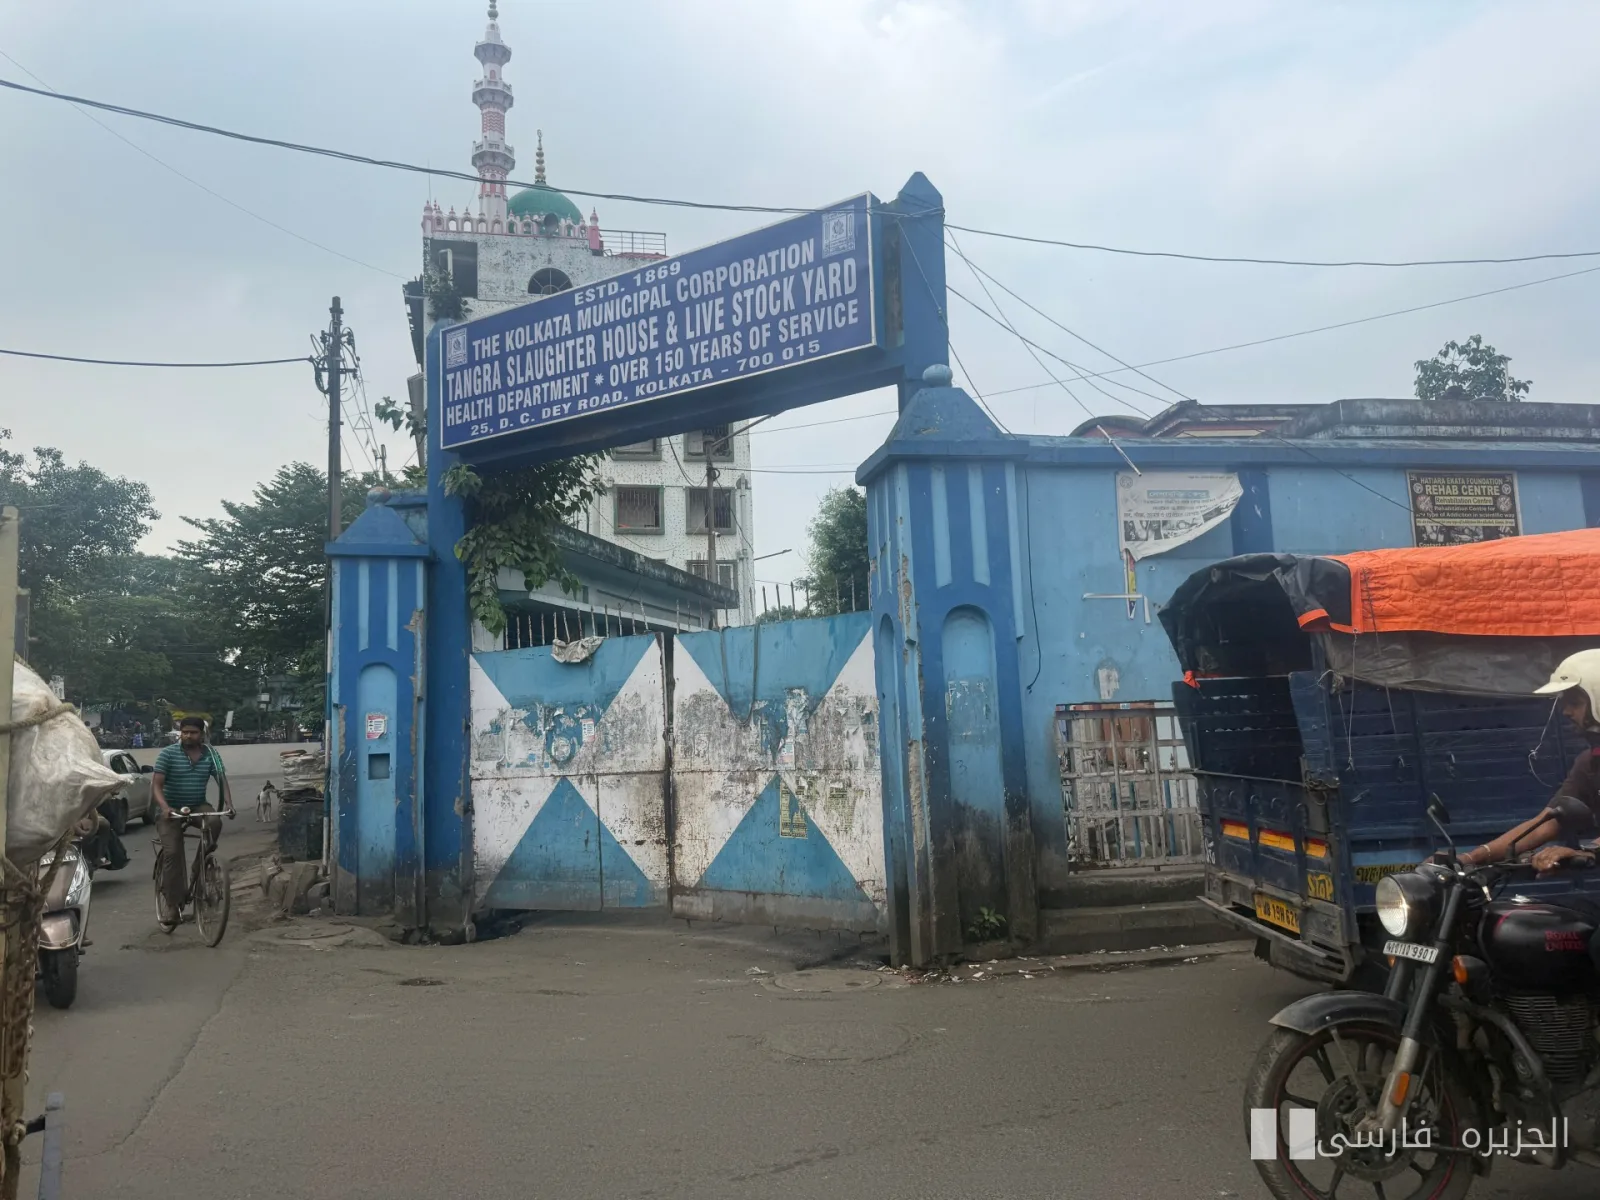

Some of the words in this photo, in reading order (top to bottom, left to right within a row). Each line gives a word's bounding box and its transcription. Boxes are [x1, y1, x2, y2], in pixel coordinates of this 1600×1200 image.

[446, 360, 501, 402] TANGRA
[507, 334, 596, 387] SLAUGHTER
[602, 315, 659, 362] HOUSE
[666, 310, 678, 345] &
[685, 296, 724, 340] LIVE
[732, 274, 795, 327] STOCK
[801, 257, 857, 306] YARD
[472, 334, 500, 361] THE
[505, 313, 572, 352] KOLKATA
[577, 283, 671, 332] MUNICIPAL
[676, 238, 814, 302] CORPORATION
[574, 281, 625, 306] ESTD.
[633, 261, 681, 287] 1869
[446, 397, 493, 426] HEALTH
[498, 372, 590, 414] DEPARTMENT
[609, 356, 649, 387] OVER
[655, 347, 684, 375] 150
[690, 331, 742, 366] YEARS
[749, 322, 771, 350] OF
[778, 298, 858, 343] SERVICE
[470, 422, 493, 436] 25,
[542, 402, 572, 419] DEY
[577, 391, 628, 411] ROAD,
[635, 368, 713, 397] KOLKATA
[736, 352, 774, 371] 700
[782, 339, 820, 360] 015
[1420, 477, 1446, 485] HATIARA
[1446, 477, 1466, 485] EKATA
[1425, 484, 1459, 495] REHAB
[1461, 484, 1500, 495] CENTRE
